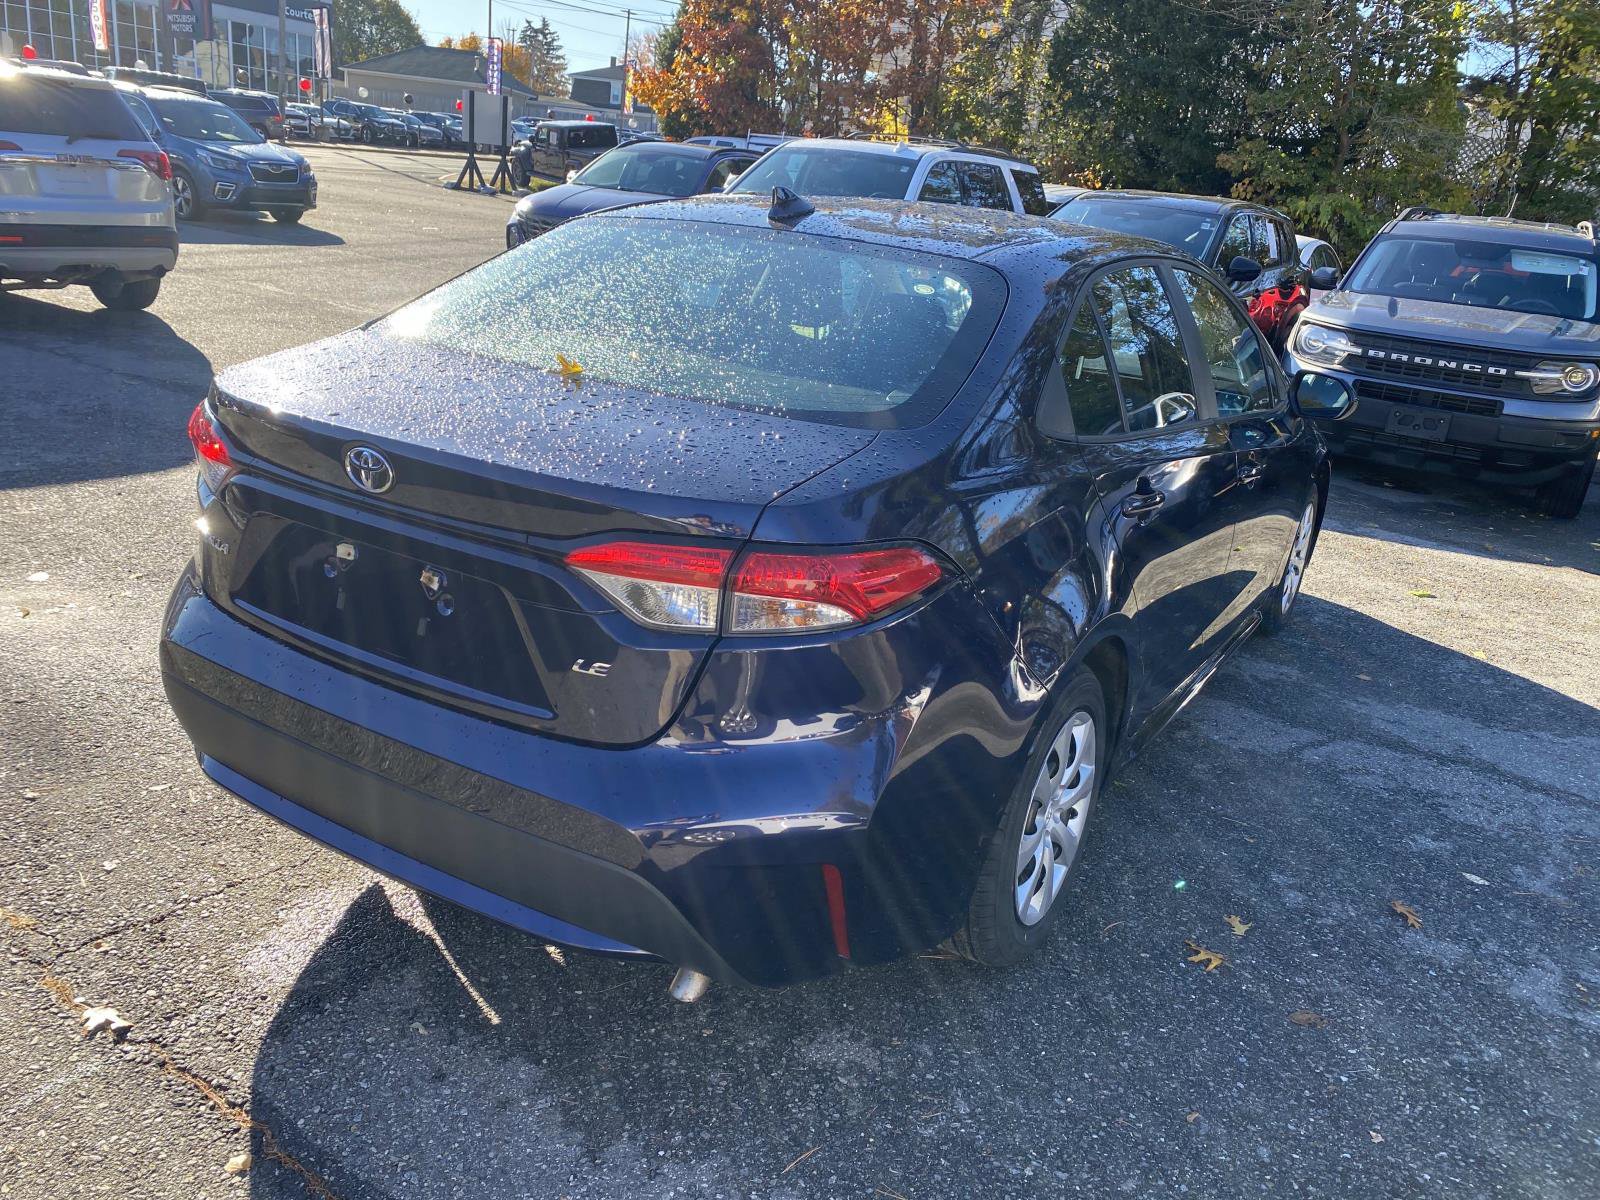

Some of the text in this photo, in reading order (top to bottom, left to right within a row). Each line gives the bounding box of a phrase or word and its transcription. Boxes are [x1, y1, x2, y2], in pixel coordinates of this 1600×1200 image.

[166, 14, 196, 23] MITSUBISHI
[171, 23, 193, 33] MOTORS
[1367, 349, 1507, 375] BRONCO
[571, 658, 612, 677] LE
